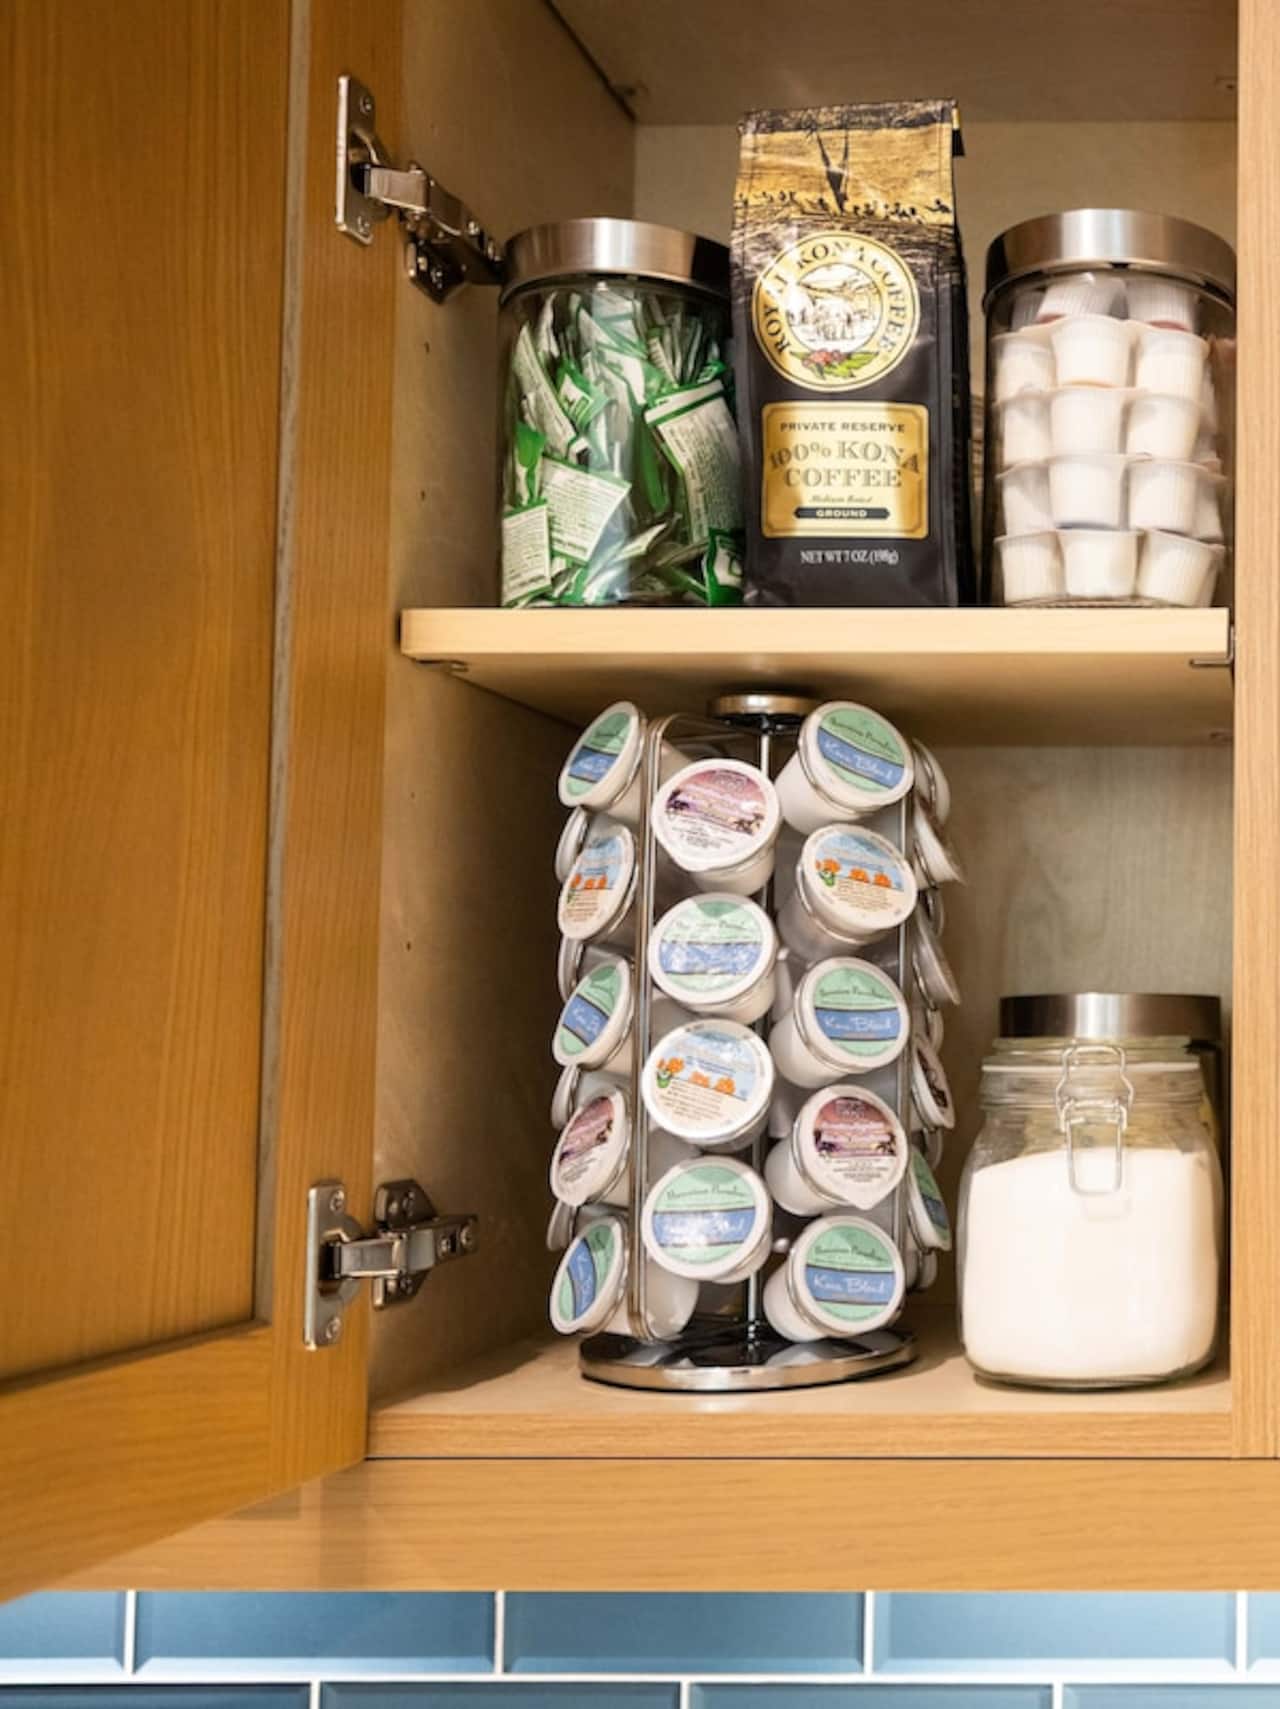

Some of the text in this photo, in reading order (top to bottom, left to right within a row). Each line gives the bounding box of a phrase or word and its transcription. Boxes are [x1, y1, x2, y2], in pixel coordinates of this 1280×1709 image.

[763, 272, 792, 353] ROYL
[870, 258, 908, 354] COFFEE
[780, 421, 905, 433] PRIVATE RESERVE
[769, 440, 920, 474] 100% KONA
[784, 467, 903, 488] COFFEE
[815, 509, 868, 518] GROUND
[800, 550, 823, 565] NET
[824, 550, 843, 564] WT
